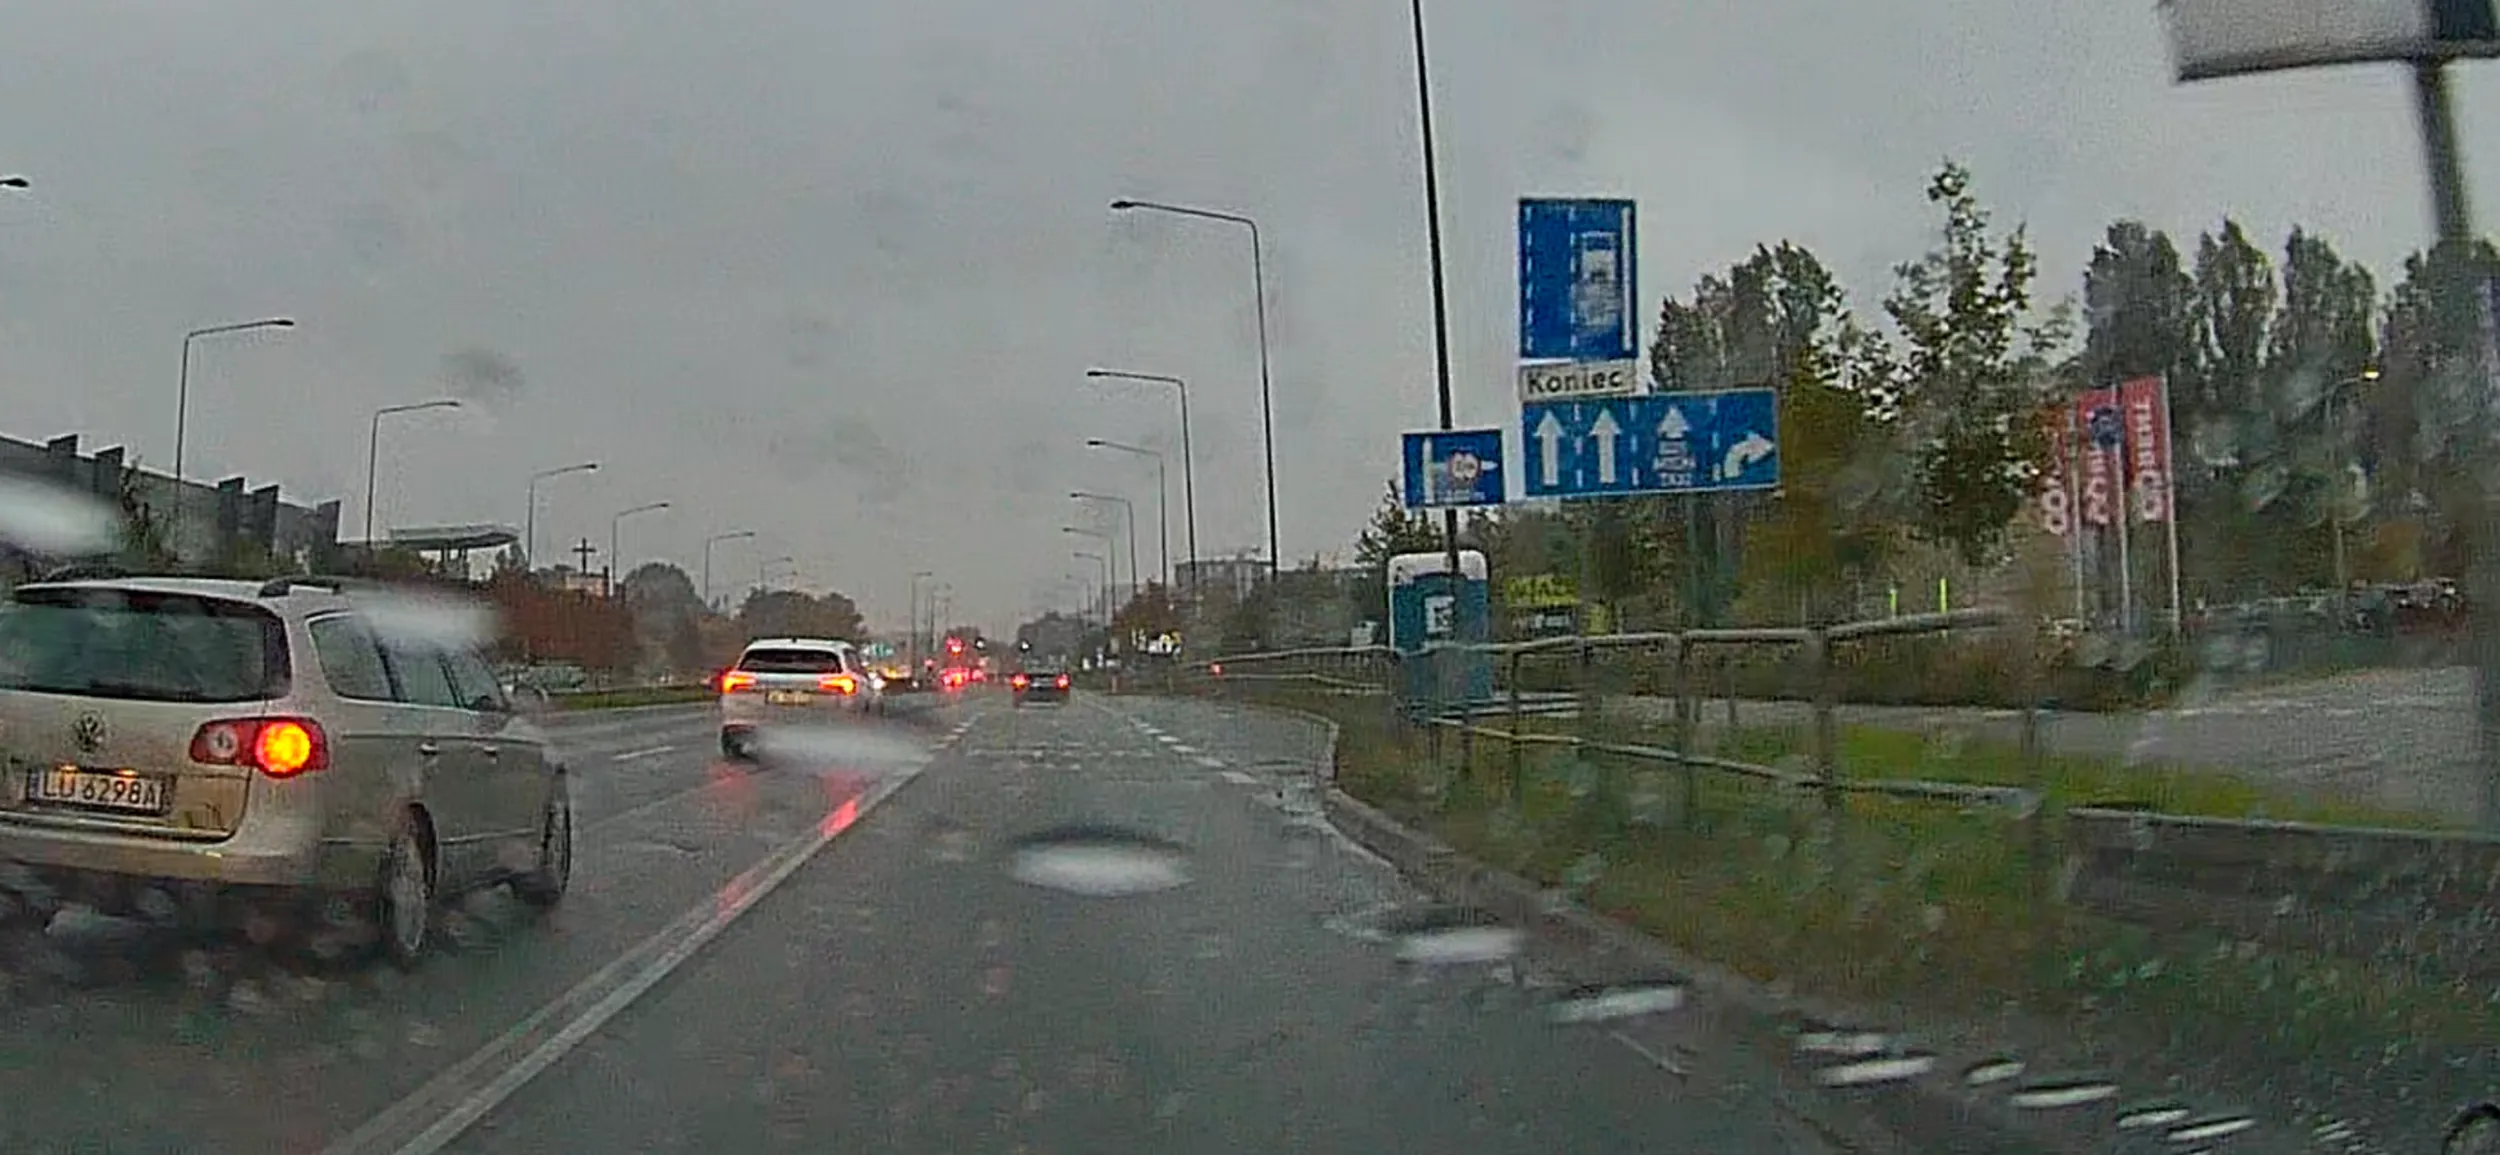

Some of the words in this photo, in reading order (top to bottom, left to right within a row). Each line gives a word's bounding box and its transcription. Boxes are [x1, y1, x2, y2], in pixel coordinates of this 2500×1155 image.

[1526, 369, 1625, 393] Koniec
[42, 771, 76, 799] LU
[83, 777, 157, 807] 6298A
